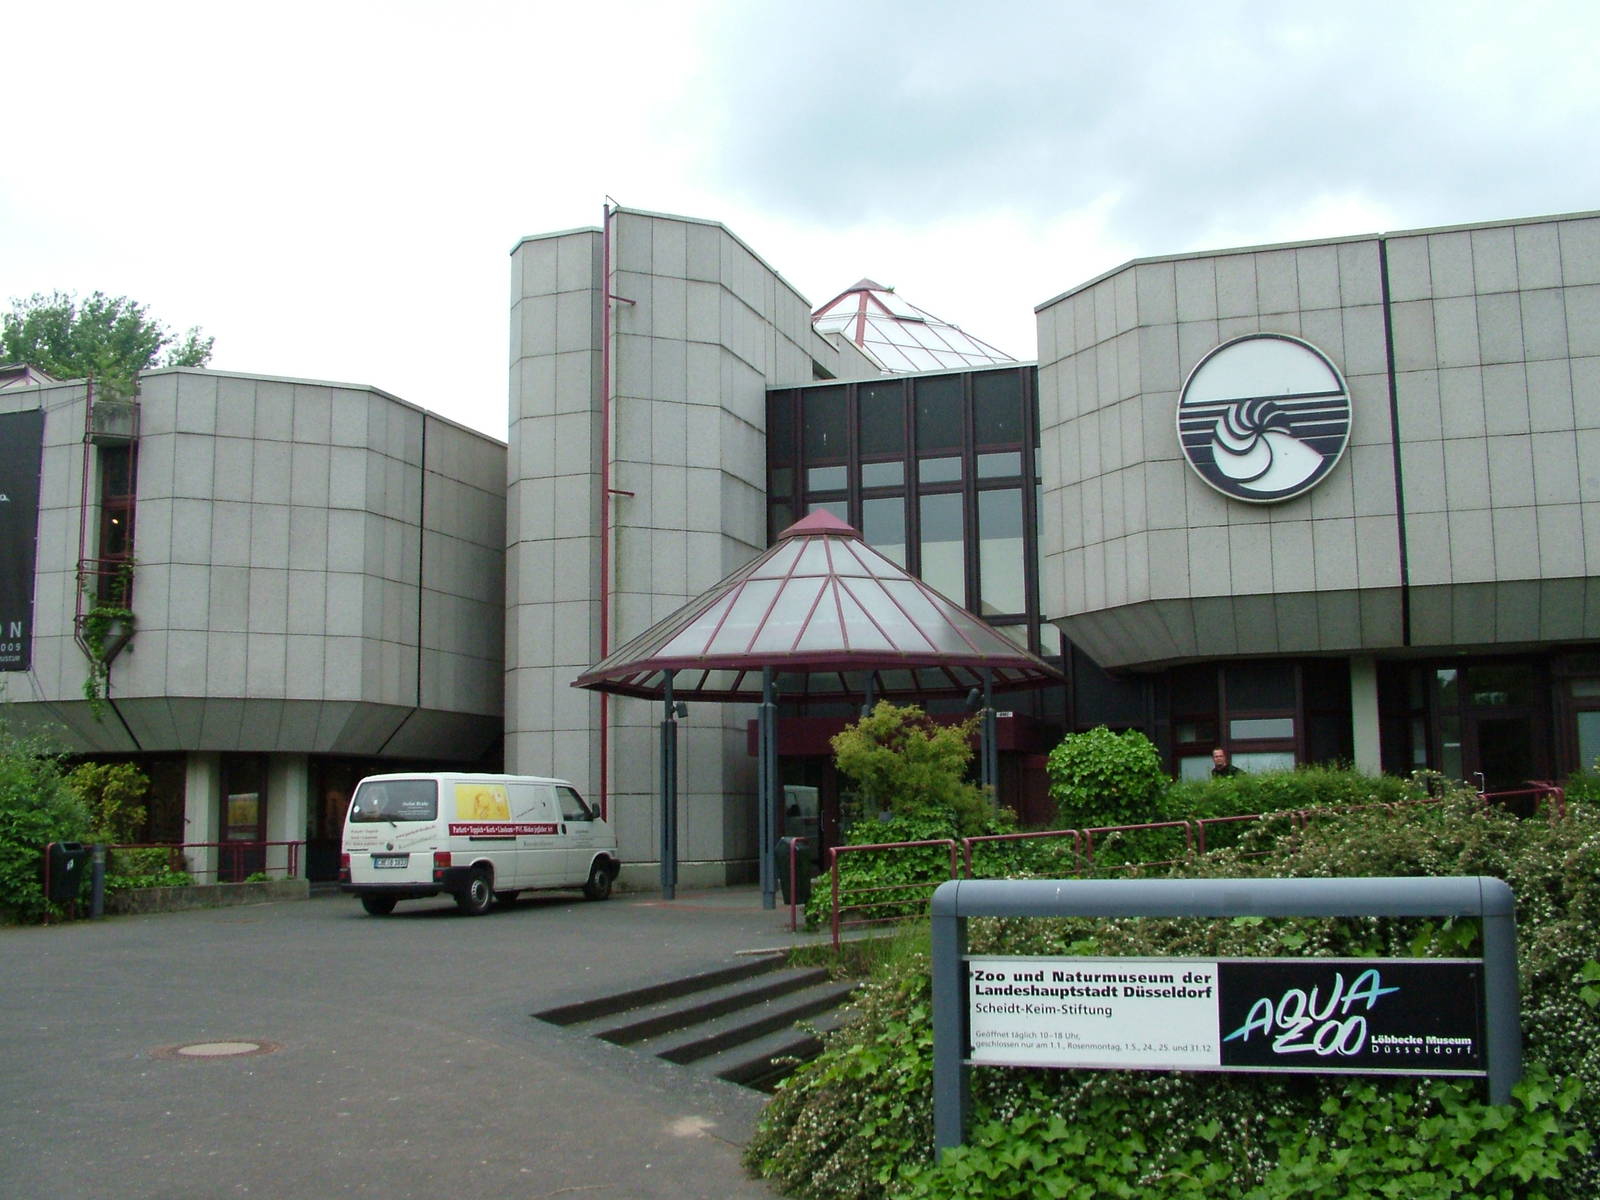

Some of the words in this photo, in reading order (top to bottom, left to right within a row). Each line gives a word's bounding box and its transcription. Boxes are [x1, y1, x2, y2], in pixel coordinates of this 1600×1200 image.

[974, 970, 1006, 982] Zoo
[1013, 970, 1044, 983] und
[1052, 971, 1174, 984] Naturmuseum
[1182, 971, 1212, 984] der
[975, 984, 1118, 999] Landeshauptstadt
[1123, 986, 1212, 999] Düsseldorf
[975, 1003, 1113, 1018] Scheidt-Keim-Stiftung
[1223, 968, 1400, 1042] AQUA
[975, 1030, 1009, 1039] Geöffnet
[1012, 1031, 1037, 1040] täglich
[1272, 1015, 1367, 1056] ZOO
[1371, 1035, 1424, 1045] Löbbecke
[1426, 1035, 1472, 1045] Museum
[975, 1040, 1020, 1049] geschlossen
[1021, 1041, 1034, 1049] nur
[1172, 1043, 1188, 1052] und
[1372, 1045, 1472, 1055] Düsseldorf
